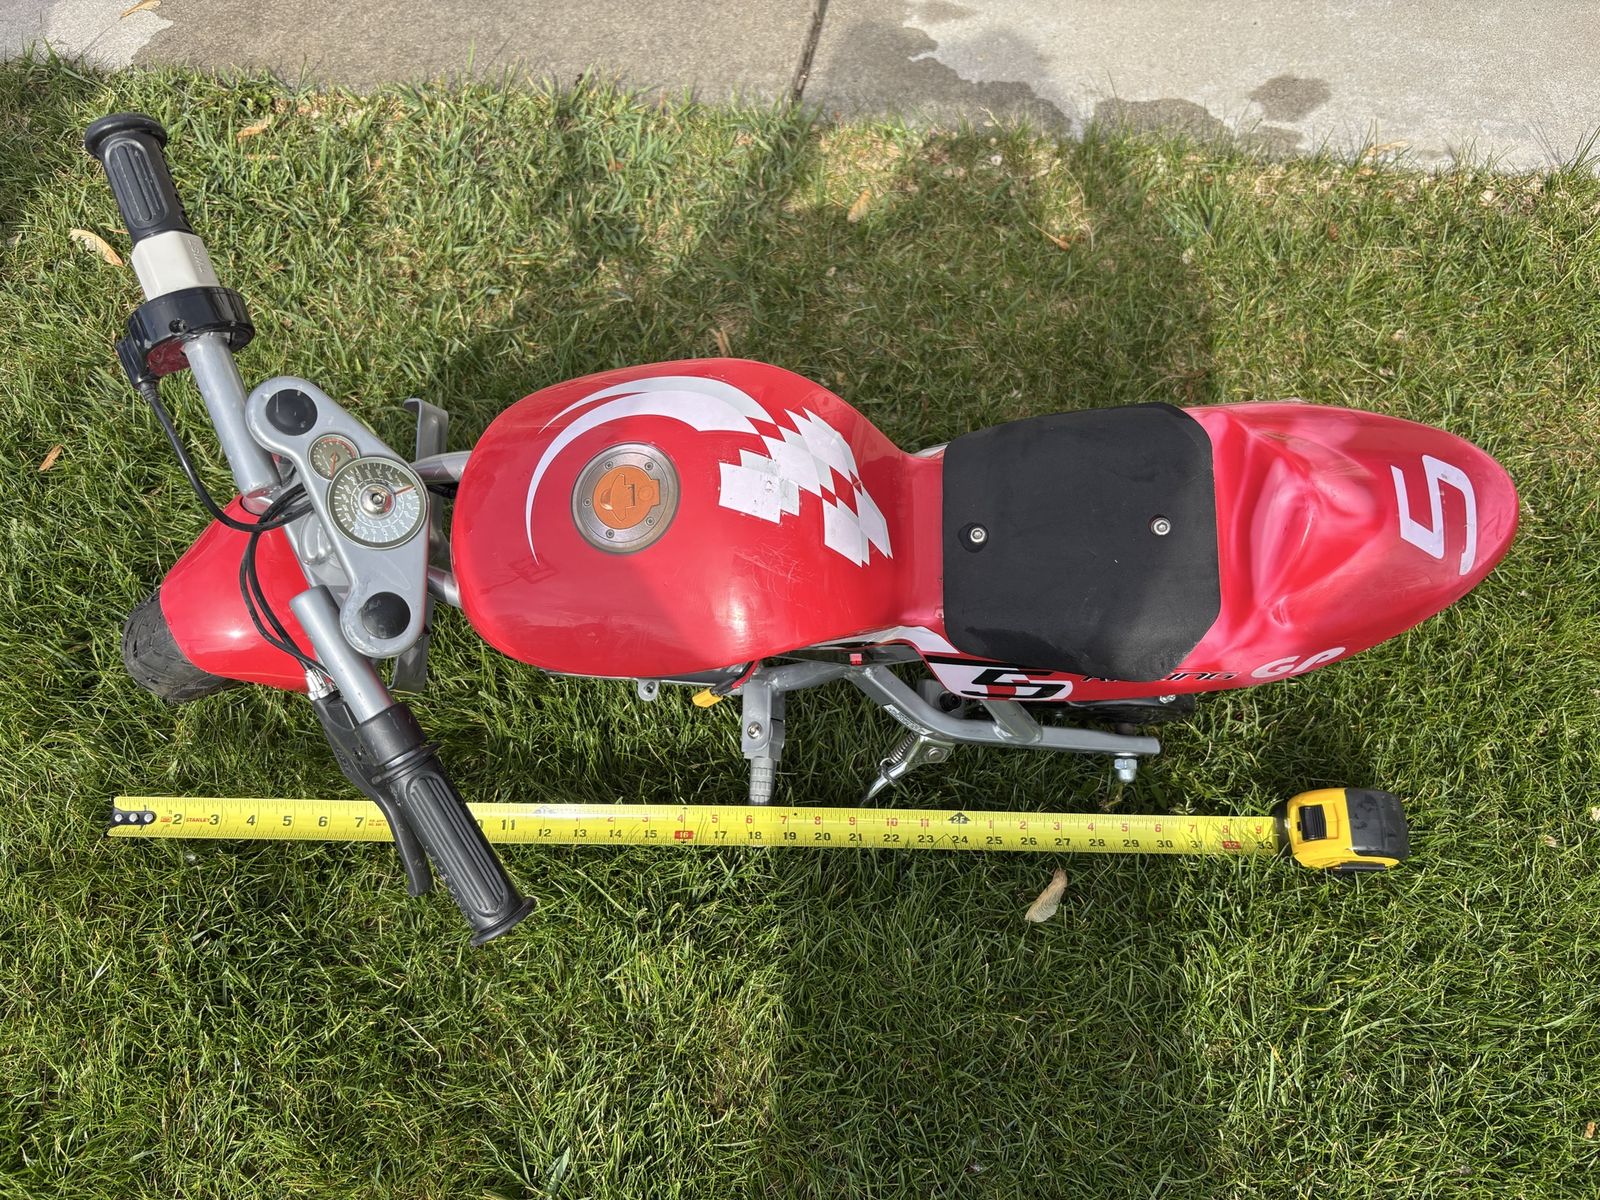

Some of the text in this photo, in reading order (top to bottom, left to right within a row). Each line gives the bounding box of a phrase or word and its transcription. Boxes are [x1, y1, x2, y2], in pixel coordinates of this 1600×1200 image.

[1250, 646, 1346, 678] GP
[172, 814, 182, 825] 2
[209, 814, 219, 826] 3
[246, 815, 256, 826] 4
[282, 816, 292, 826] 5
[318, 816, 328, 827] 6
[354, 817, 364, 828] 7
[501, 820, 516, 830] 11
[538, 828, 550, 838] 12
[574, 829, 586, 838] 13
[608, 830, 622, 838] 14
[644, 830, 657, 838] 15
[714, 830, 727, 839] 17
[748, 831, 762, 840] 18
[784, 832, 796, 840] 19
[815, 832, 830, 841] 20
[849, 833, 862, 842] 21
[884, 834, 900, 842] 22
[918, 834, 934, 843] 23
[952, 836, 968, 844] 24
[986, 836, 1002, 845] 25
[1020, 837, 1037, 846] 26
[1055, 838, 1070, 846] 27
[1088, 838, 1105, 846] 28
[1122, 839, 1140, 848] 29
[1157, 840, 1173, 848] 30
[1258, 841, 1274, 850] 33
[677, 814, 684, 823] 4
[712, 814, 718, 823] 5
[746, 815, 752, 824] 6
[781, 816, 788, 824] 7
[814, 816, 822, 825] 8
[848, 816, 856, 826] 9
[886, 818, 898, 826] 10
[1020, 820, 1026, 830] 2
[1054, 822, 1060, 830] 3
[1088, 822, 1094, 831] 4
[1122, 823, 1128, 832] 5
[1154, 824, 1162, 833] 6
[1189, 824, 1195, 833] 7
[1222, 824, 1228, 834] 8
[1256, 825, 1262, 834] 9
